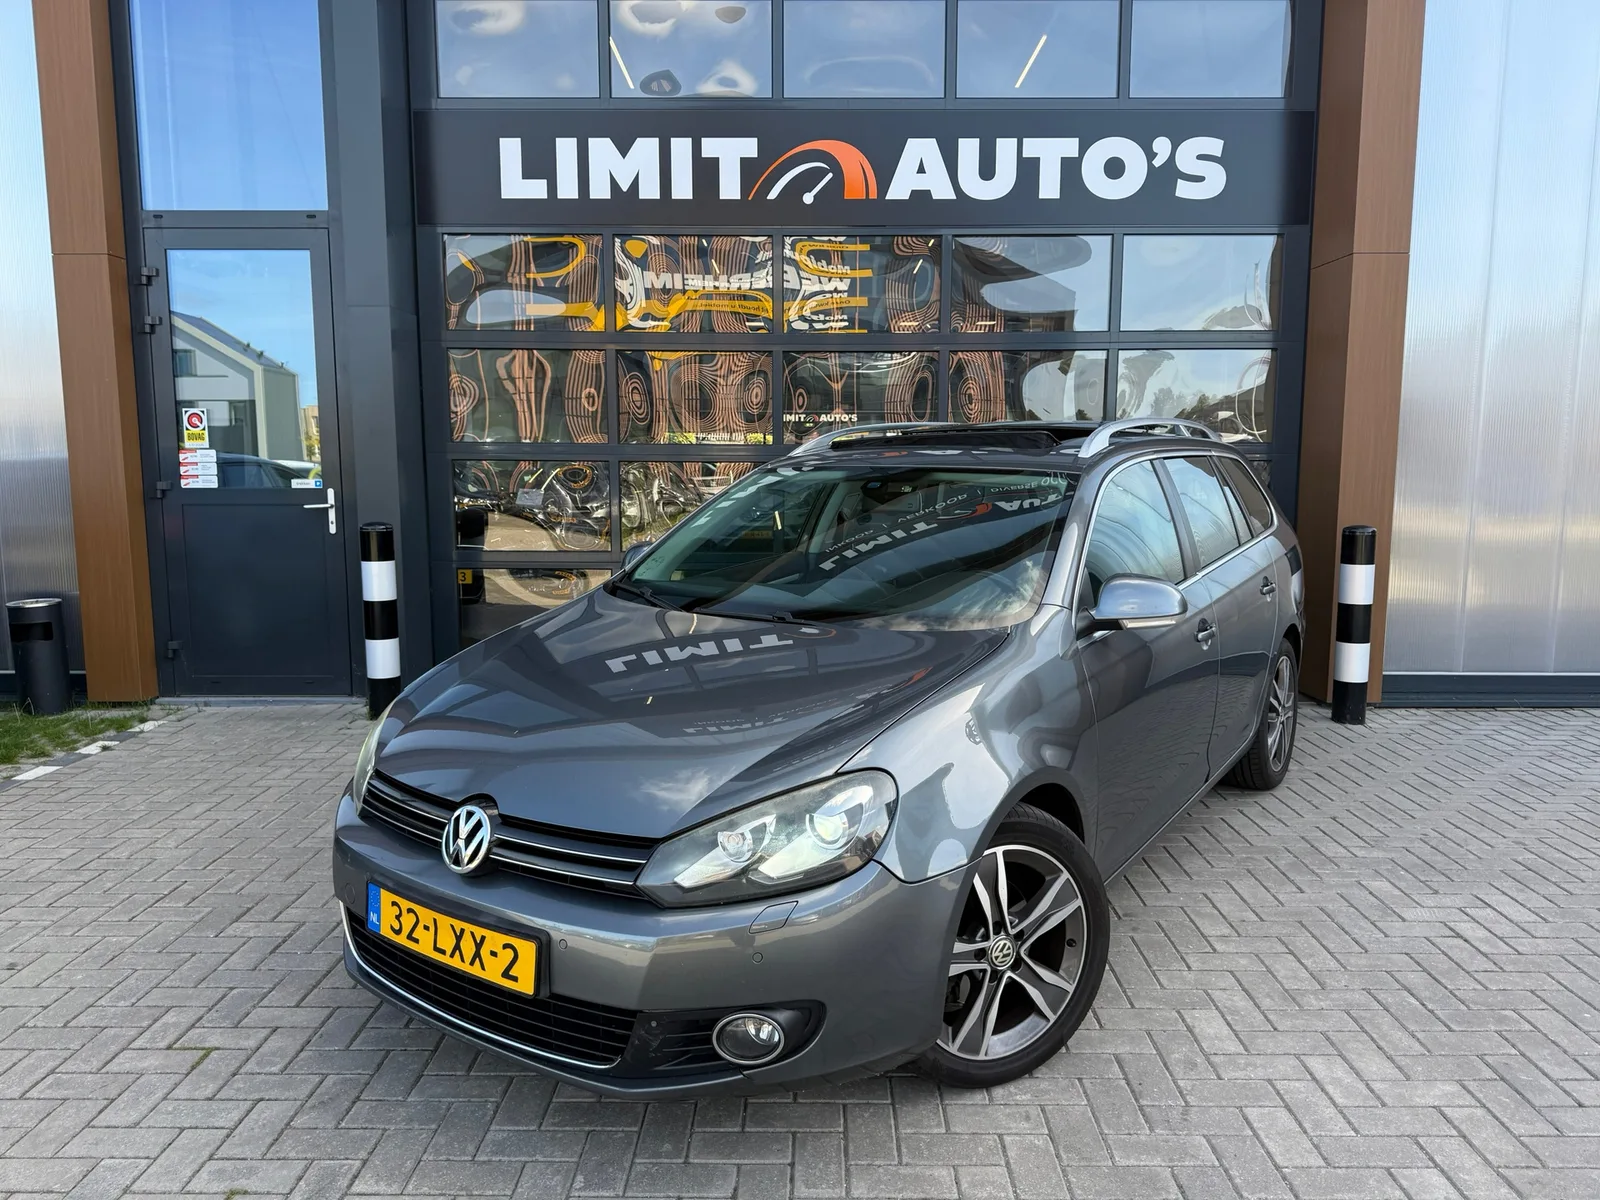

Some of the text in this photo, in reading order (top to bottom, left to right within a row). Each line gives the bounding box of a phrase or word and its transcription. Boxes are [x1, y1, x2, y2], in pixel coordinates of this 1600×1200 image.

[499, 136, 1226, 201] LIMIT AUTO'S
[783, 413, 858, 422] IMIT AUTO'S
[187, 432, 206, 442] BOVAG
[459, 571, 467, 582] 3
[369, 910, 380, 926] NL
[389, 899, 519, 984] 32-LXX-2
